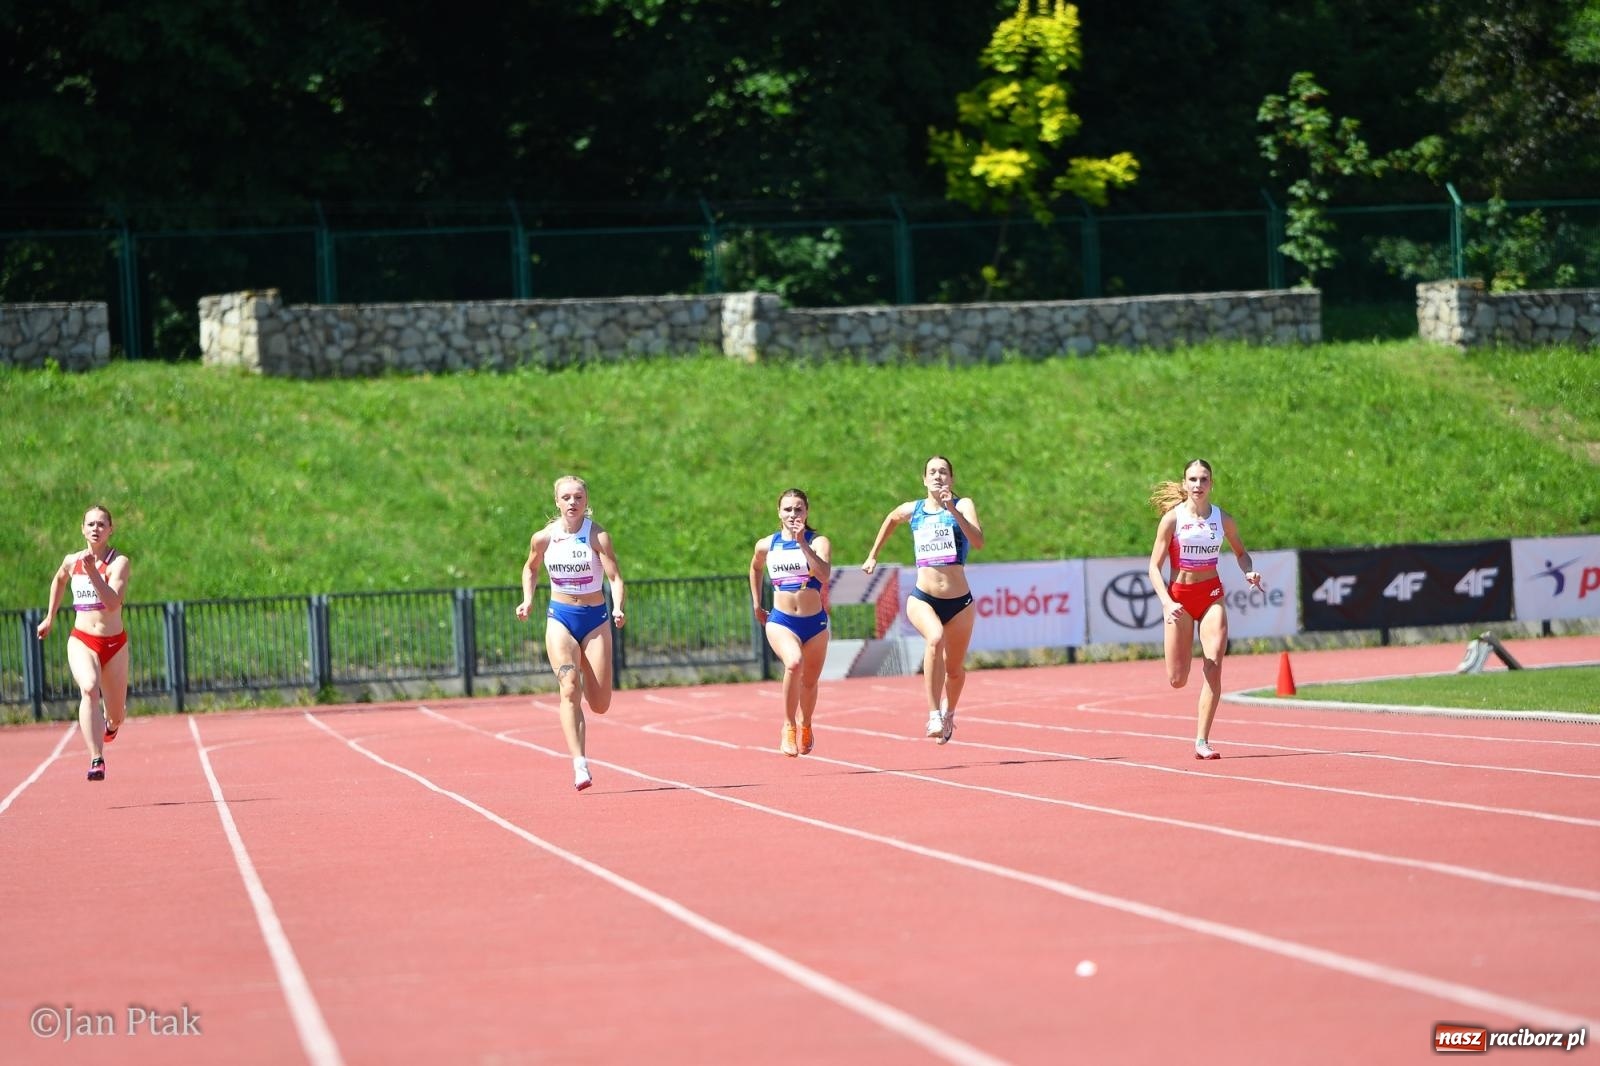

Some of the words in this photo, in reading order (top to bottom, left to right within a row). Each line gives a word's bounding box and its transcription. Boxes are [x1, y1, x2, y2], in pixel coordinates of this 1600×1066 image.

[935, 528, 949, 538] 502
[1210, 532, 1216, 540] 3
[572, 550, 587, 559] 101
[1182, 545, 1220, 554] TITTINGER
[548, 562, 591, 573] MITYSKOVÁ
[772, 562, 801, 573] SHVAB
[1312, 575, 1356, 605] 4F
[1383, 571, 1426, 601] 4F
[1454, 567, 1498, 597] 4F
[76, 590, 98, 598] DARA
[976, 585, 1070, 618] cibórz
